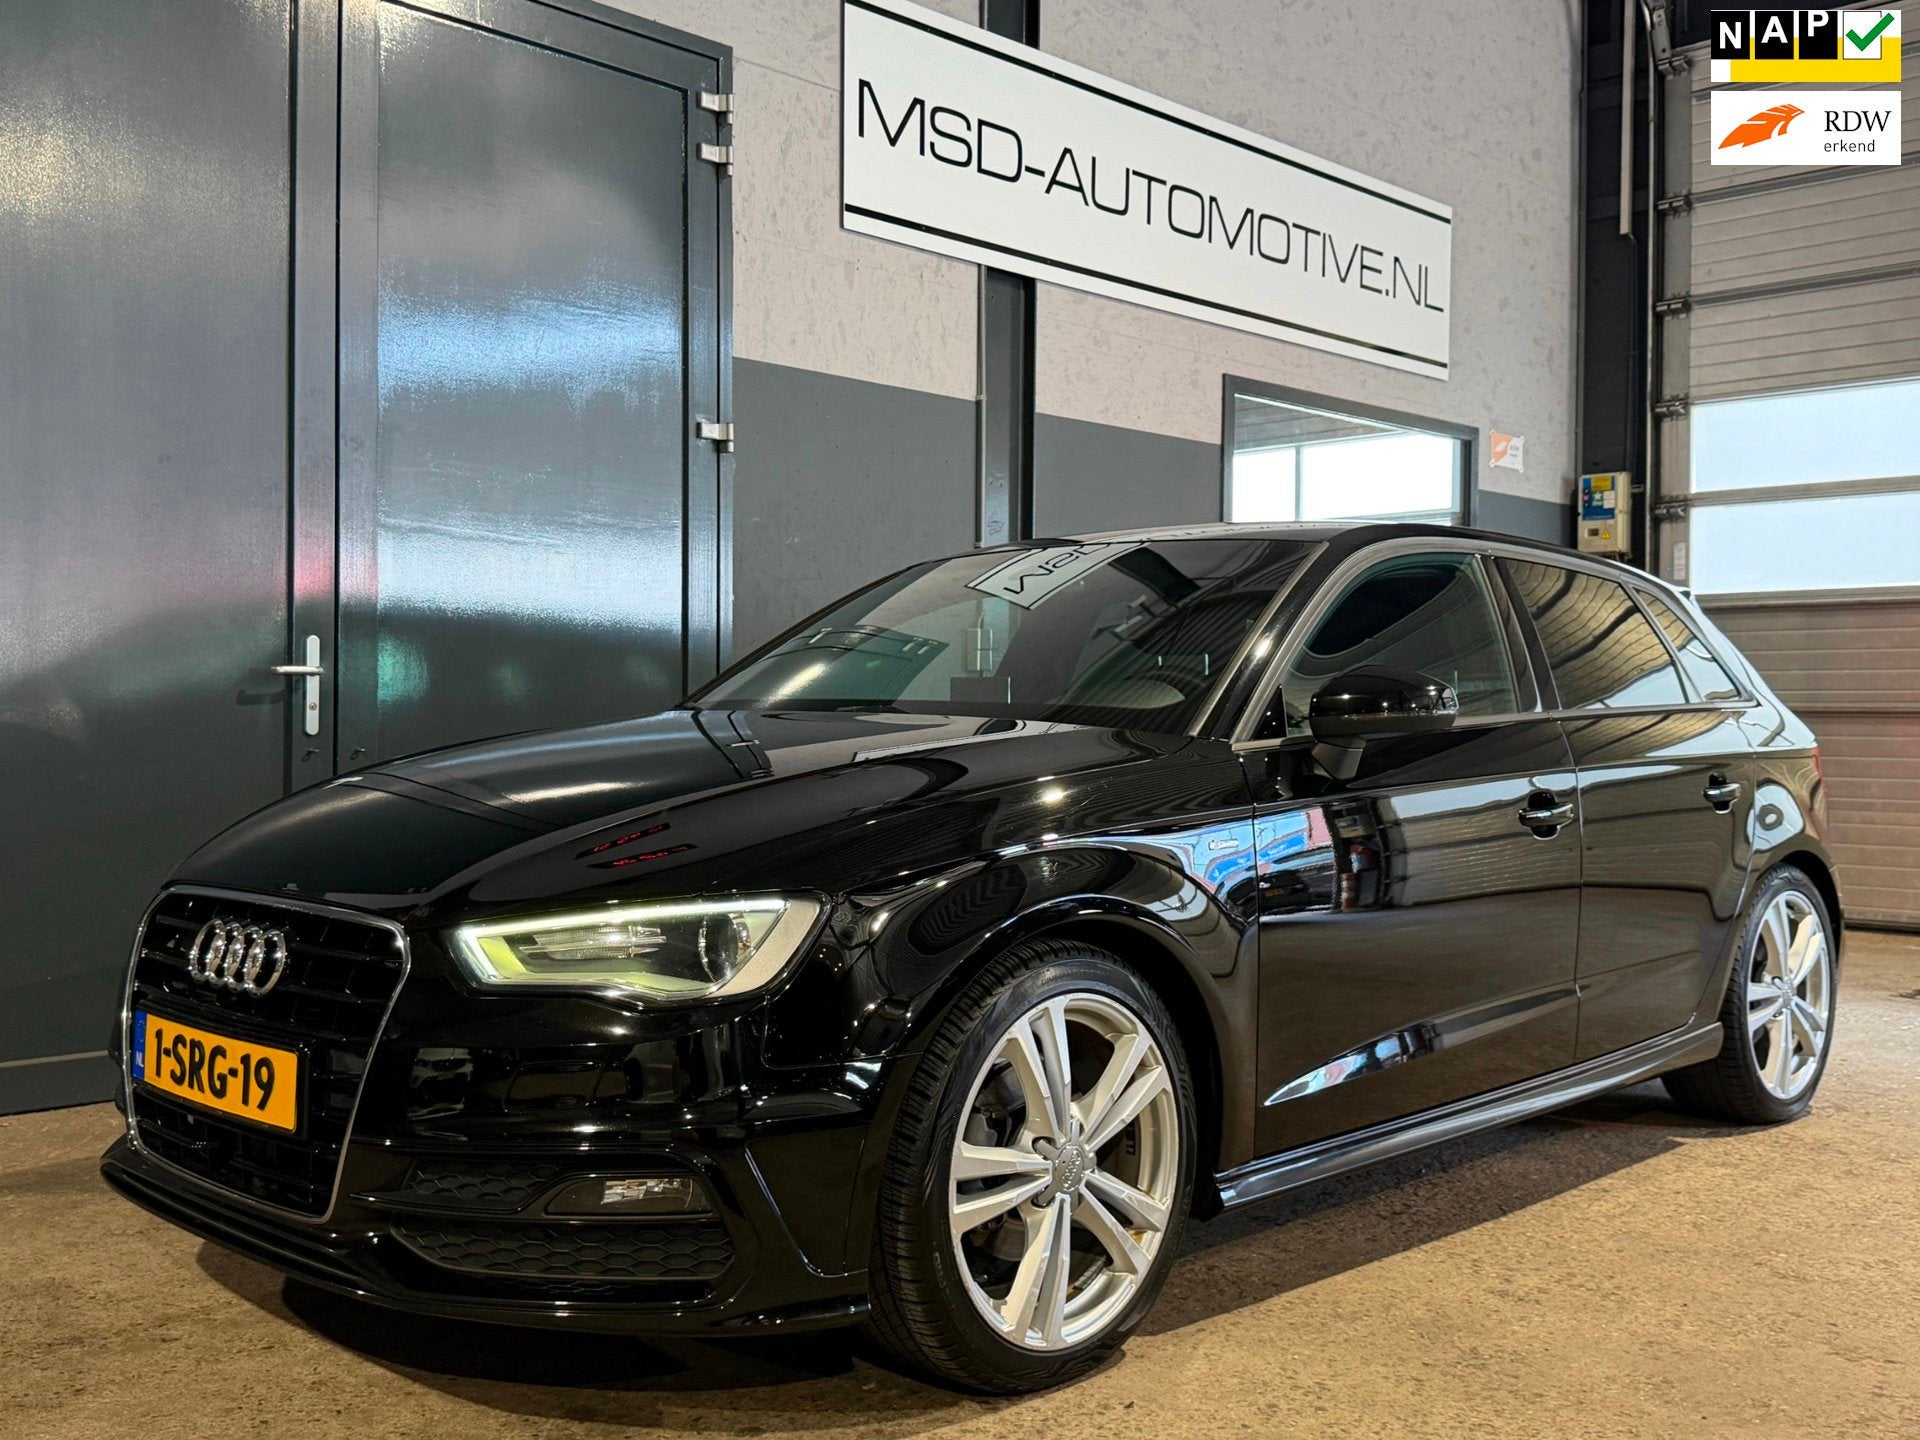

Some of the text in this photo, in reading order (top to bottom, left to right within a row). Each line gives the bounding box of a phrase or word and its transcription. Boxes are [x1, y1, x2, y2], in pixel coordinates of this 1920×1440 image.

[858, 77, 1444, 313] MSD-AUTOMOTIVE.NL
[135, 1050, 144, 1068] NL
[155, 1027, 275, 1111] 1-SRG-19
